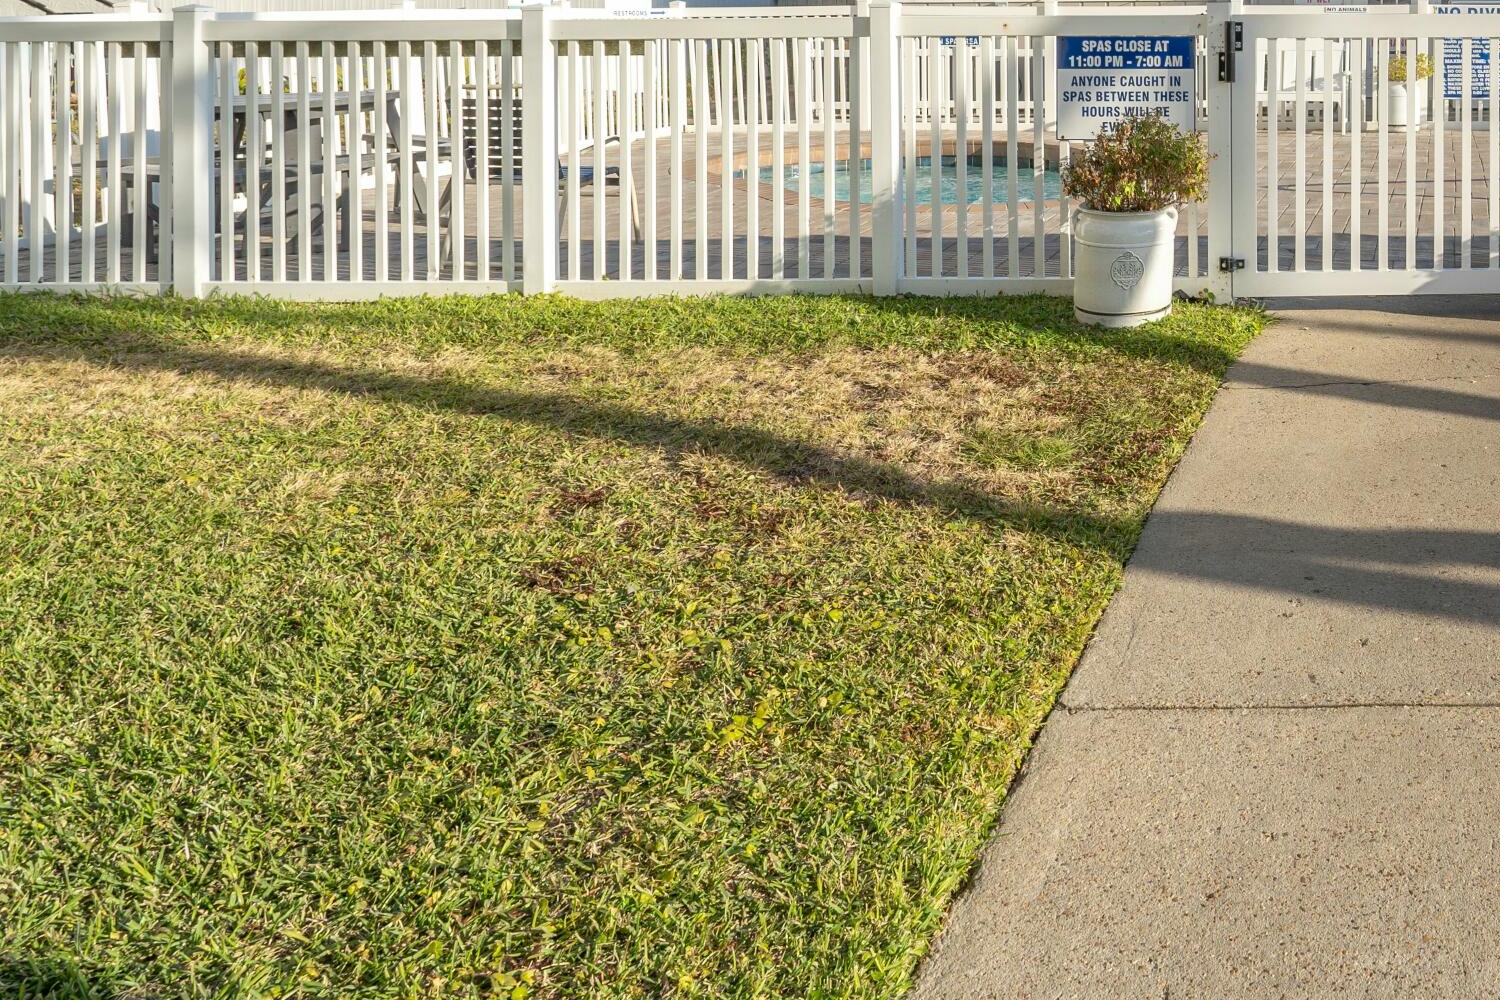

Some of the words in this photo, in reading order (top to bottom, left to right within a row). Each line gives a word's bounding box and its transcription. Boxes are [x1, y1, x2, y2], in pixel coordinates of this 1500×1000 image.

[1082, 40, 1112, 52] SPAS
[1115, 40, 1151, 52] CLOSE
[1154, 40, 1169, 52] AT
[1068, 55, 1101, 67] 11:00
[1104, 55, 1123, 67] PM
[1135, 55, 1161, 67] 7:00
[1164, 55, 1183, 67] AM
[1071, 76, 1116, 86] ANYONE
[1120, 76, 1166, 86] CAUGHT
[1169, 76, 1181, 86] IN
[1063, 91, 1092, 102] SPAS
[1096, 91, 1150, 102] BETWEEN
[1153, 91, 1189, 102] THESE
[1082, 106, 1120, 117] HOURS
